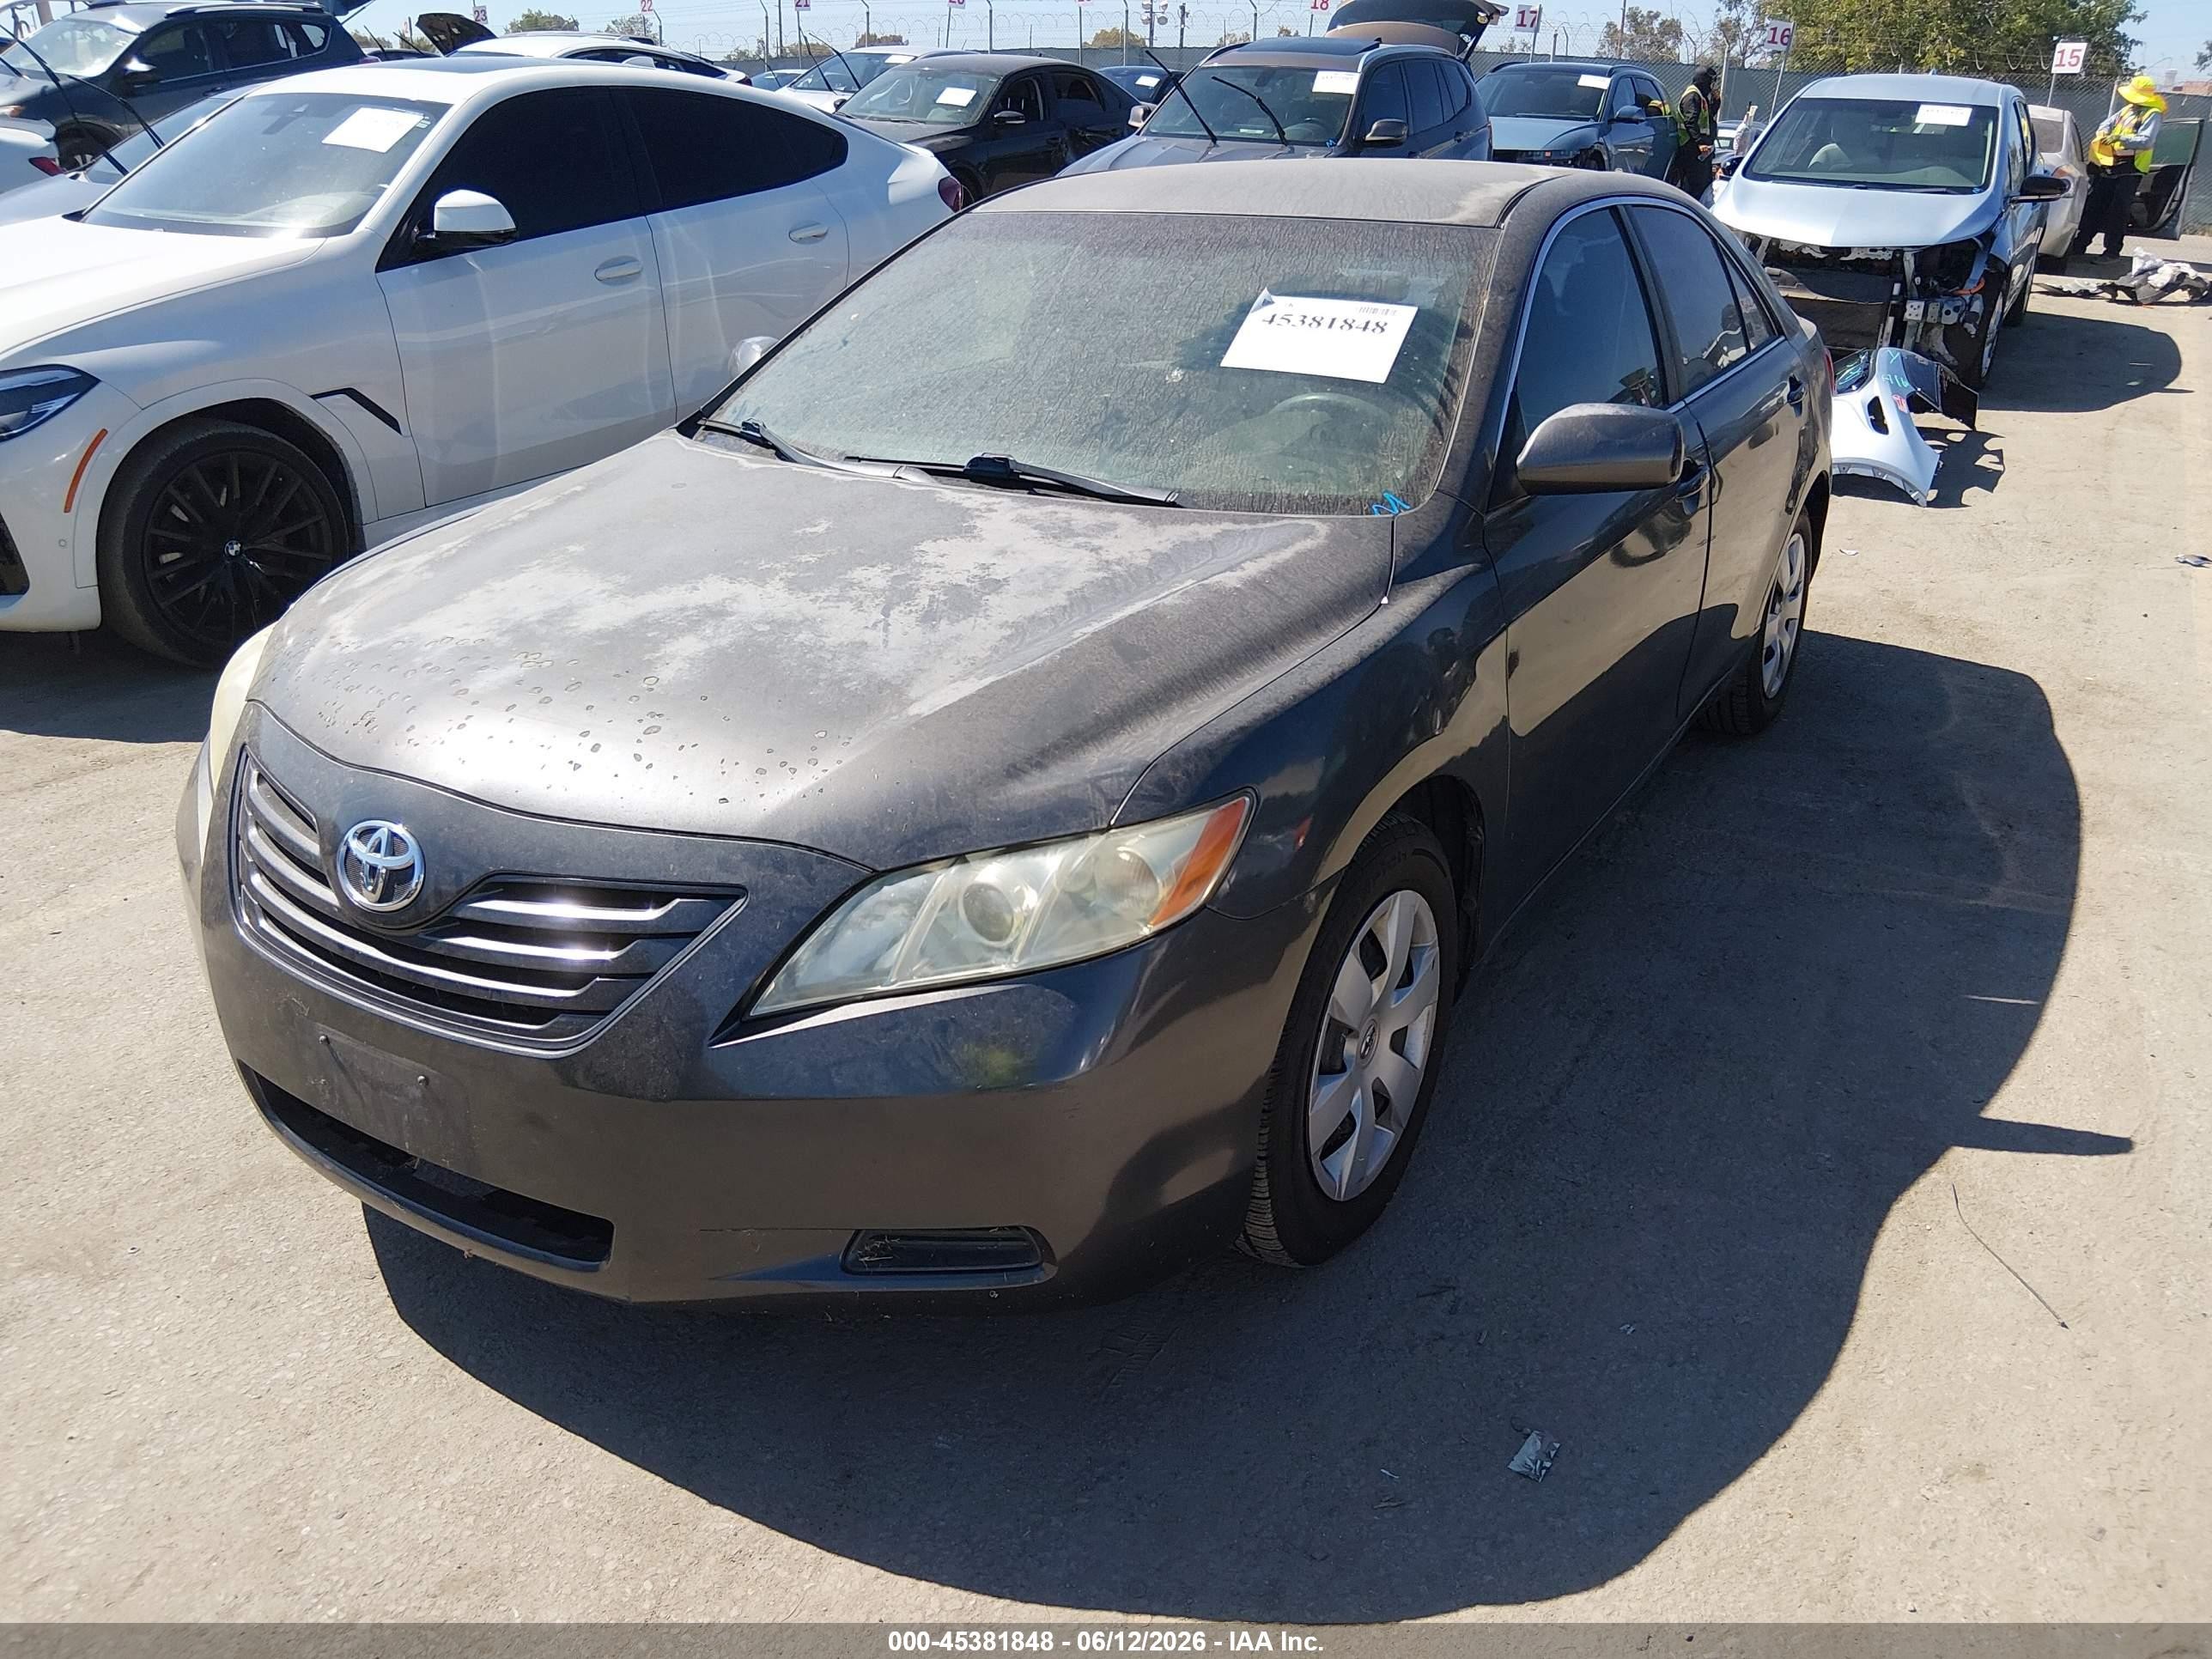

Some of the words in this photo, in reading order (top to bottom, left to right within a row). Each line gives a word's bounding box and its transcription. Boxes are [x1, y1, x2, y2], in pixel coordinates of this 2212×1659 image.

[641, 0, 653, 12] 22
[1310, 0, 1328, 10] 18
[474, 9, 487, 21] 23
[1516, 10, 1537, 27] 17
[1767, 27, 1791, 46] 16
[2054, 48, 2082, 67] 15
[1261, 313, 1389, 334] 45381848
